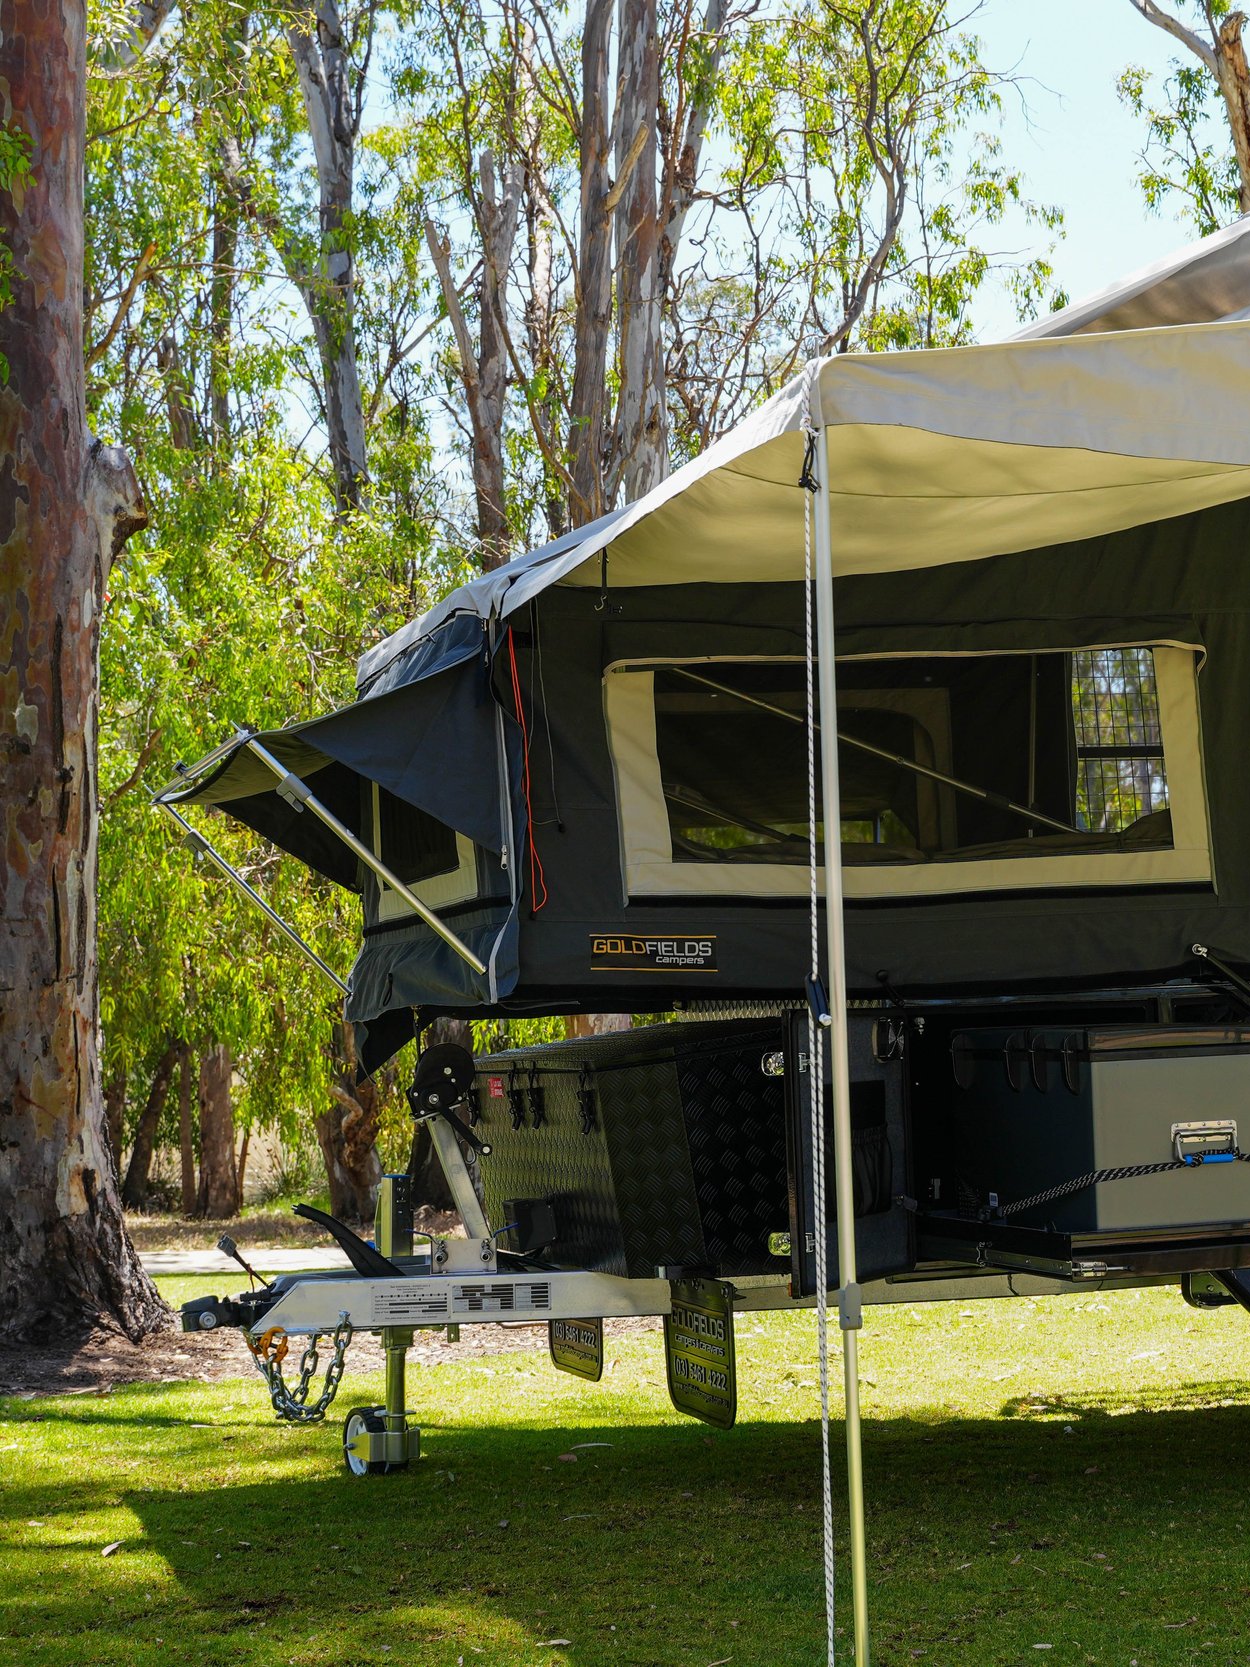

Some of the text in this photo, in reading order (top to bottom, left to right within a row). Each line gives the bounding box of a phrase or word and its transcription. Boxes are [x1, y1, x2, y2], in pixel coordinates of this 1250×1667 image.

[593, 939, 712, 957] GOLDFIELDS
[655, 956, 705, 966] campers
[671, 1306, 725, 1341] GOLDFIELDS
[674, 1354, 689, 1379] (03)
[707, 1369, 728, 1391] 4222
